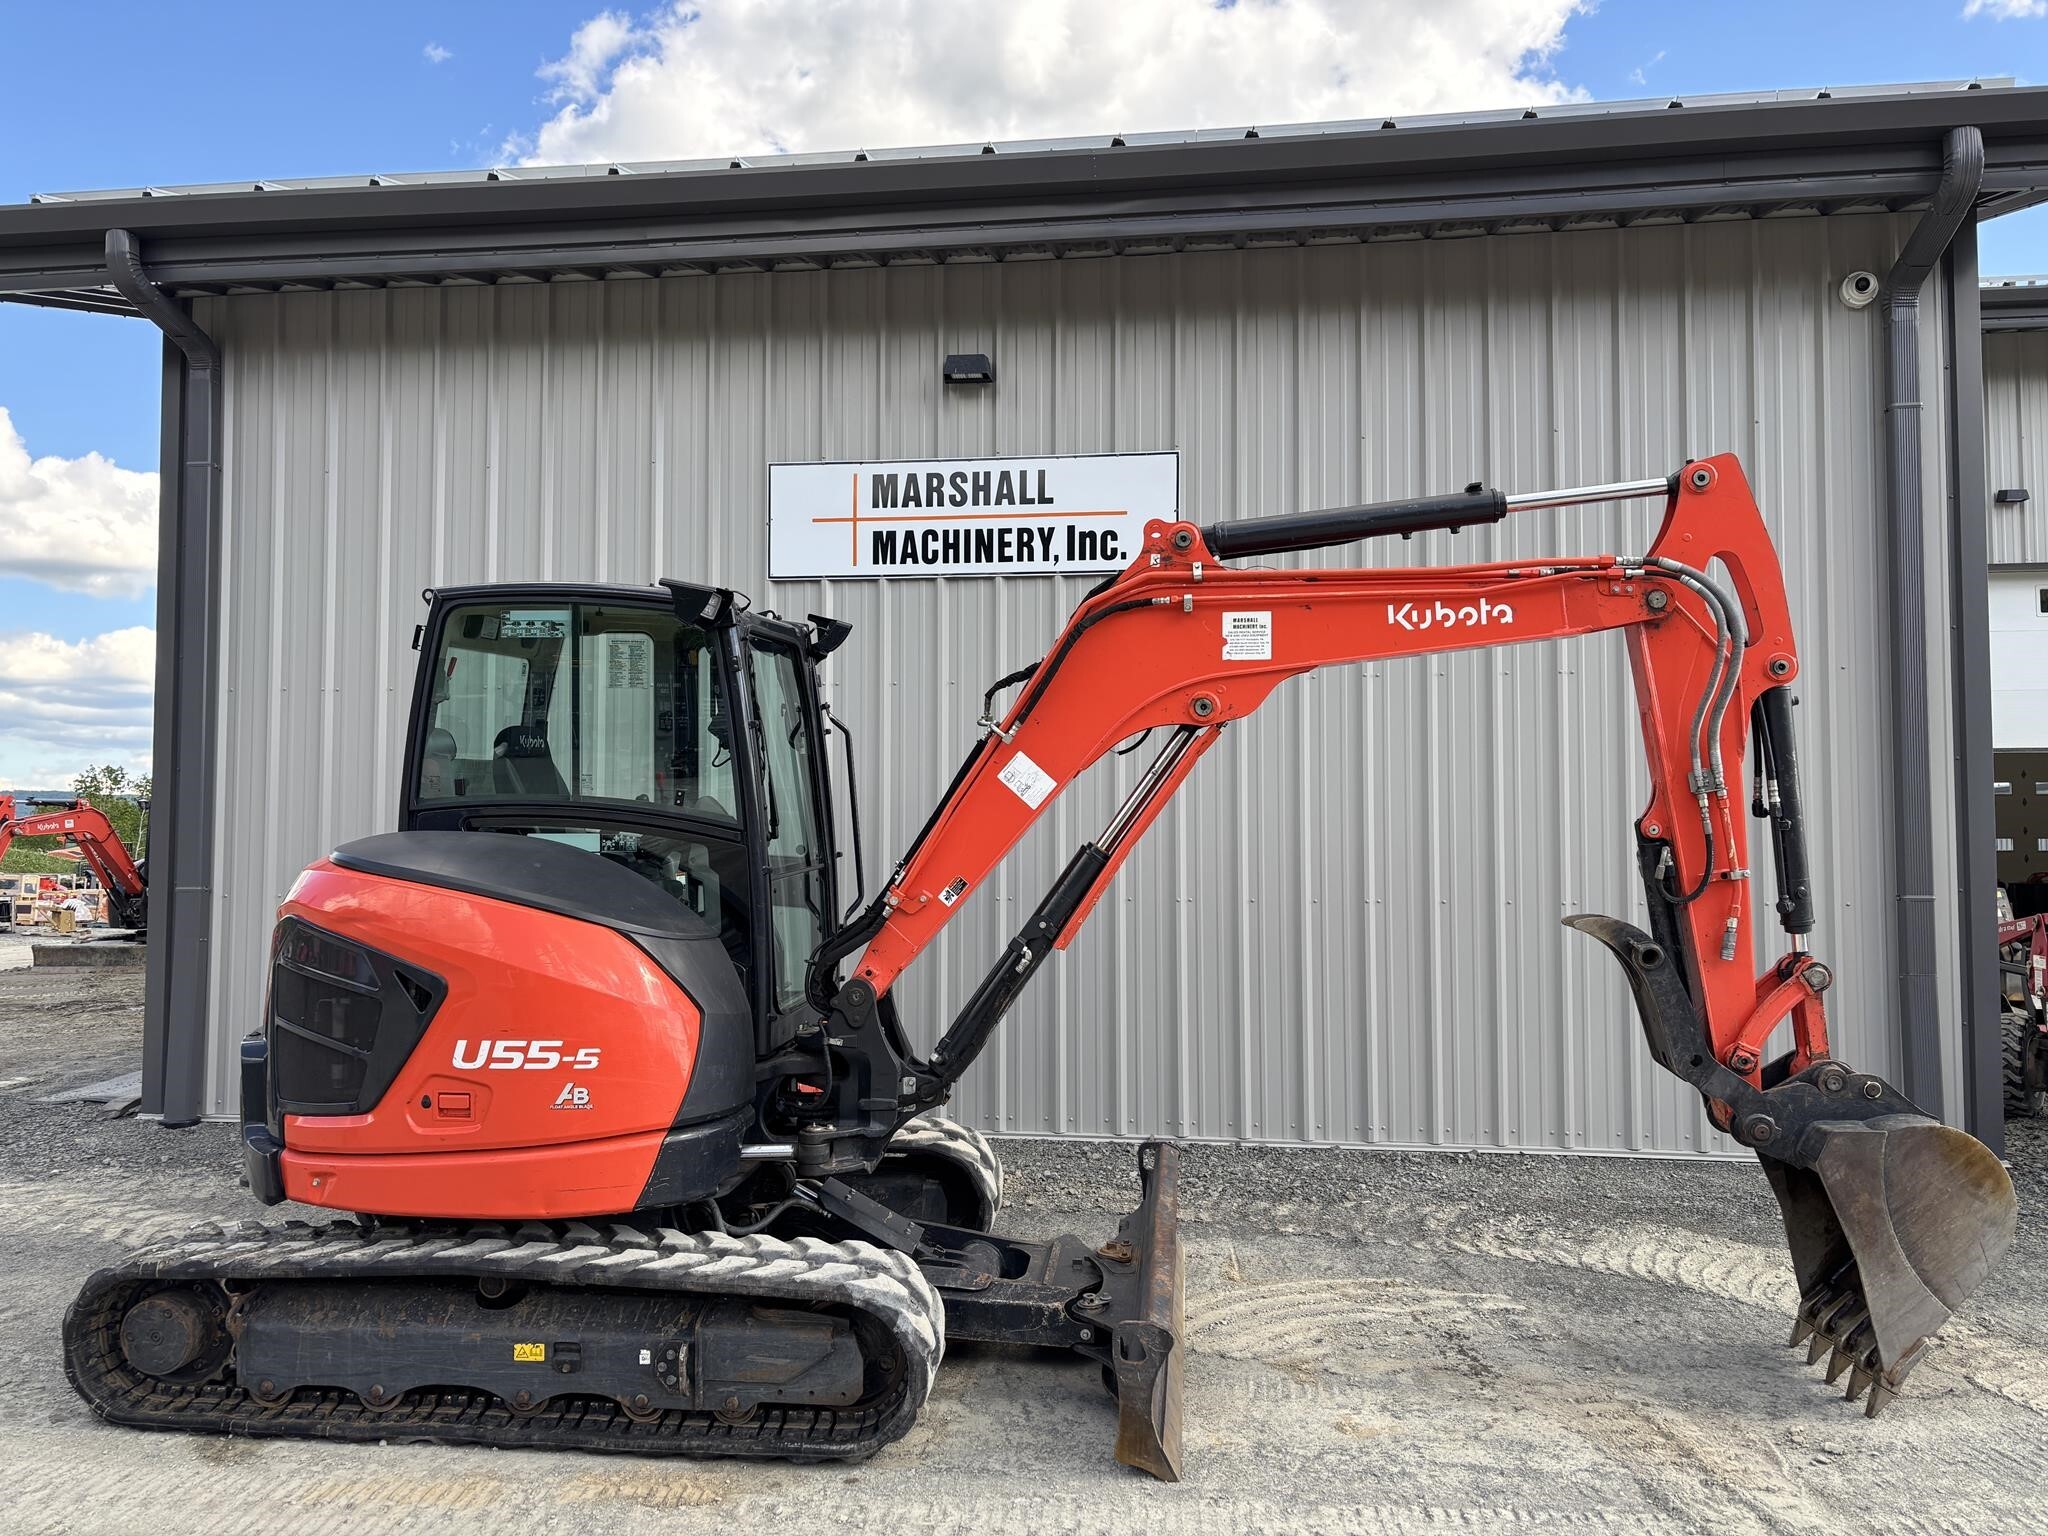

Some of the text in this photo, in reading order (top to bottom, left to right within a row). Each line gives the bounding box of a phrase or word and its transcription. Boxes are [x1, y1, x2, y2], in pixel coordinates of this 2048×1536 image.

[872, 469, 1054, 509] MARSHALL
[872, 525, 1127, 566] MACHINERY, Inc.
[1387, 597, 1513, 631] Kubota
[519, 734, 545, 748] Kubota
[37, 822, 60, 831] Kubota
[452, 1039, 602, 1070] U55-5
[555, 1082, 591, 1105] AB
